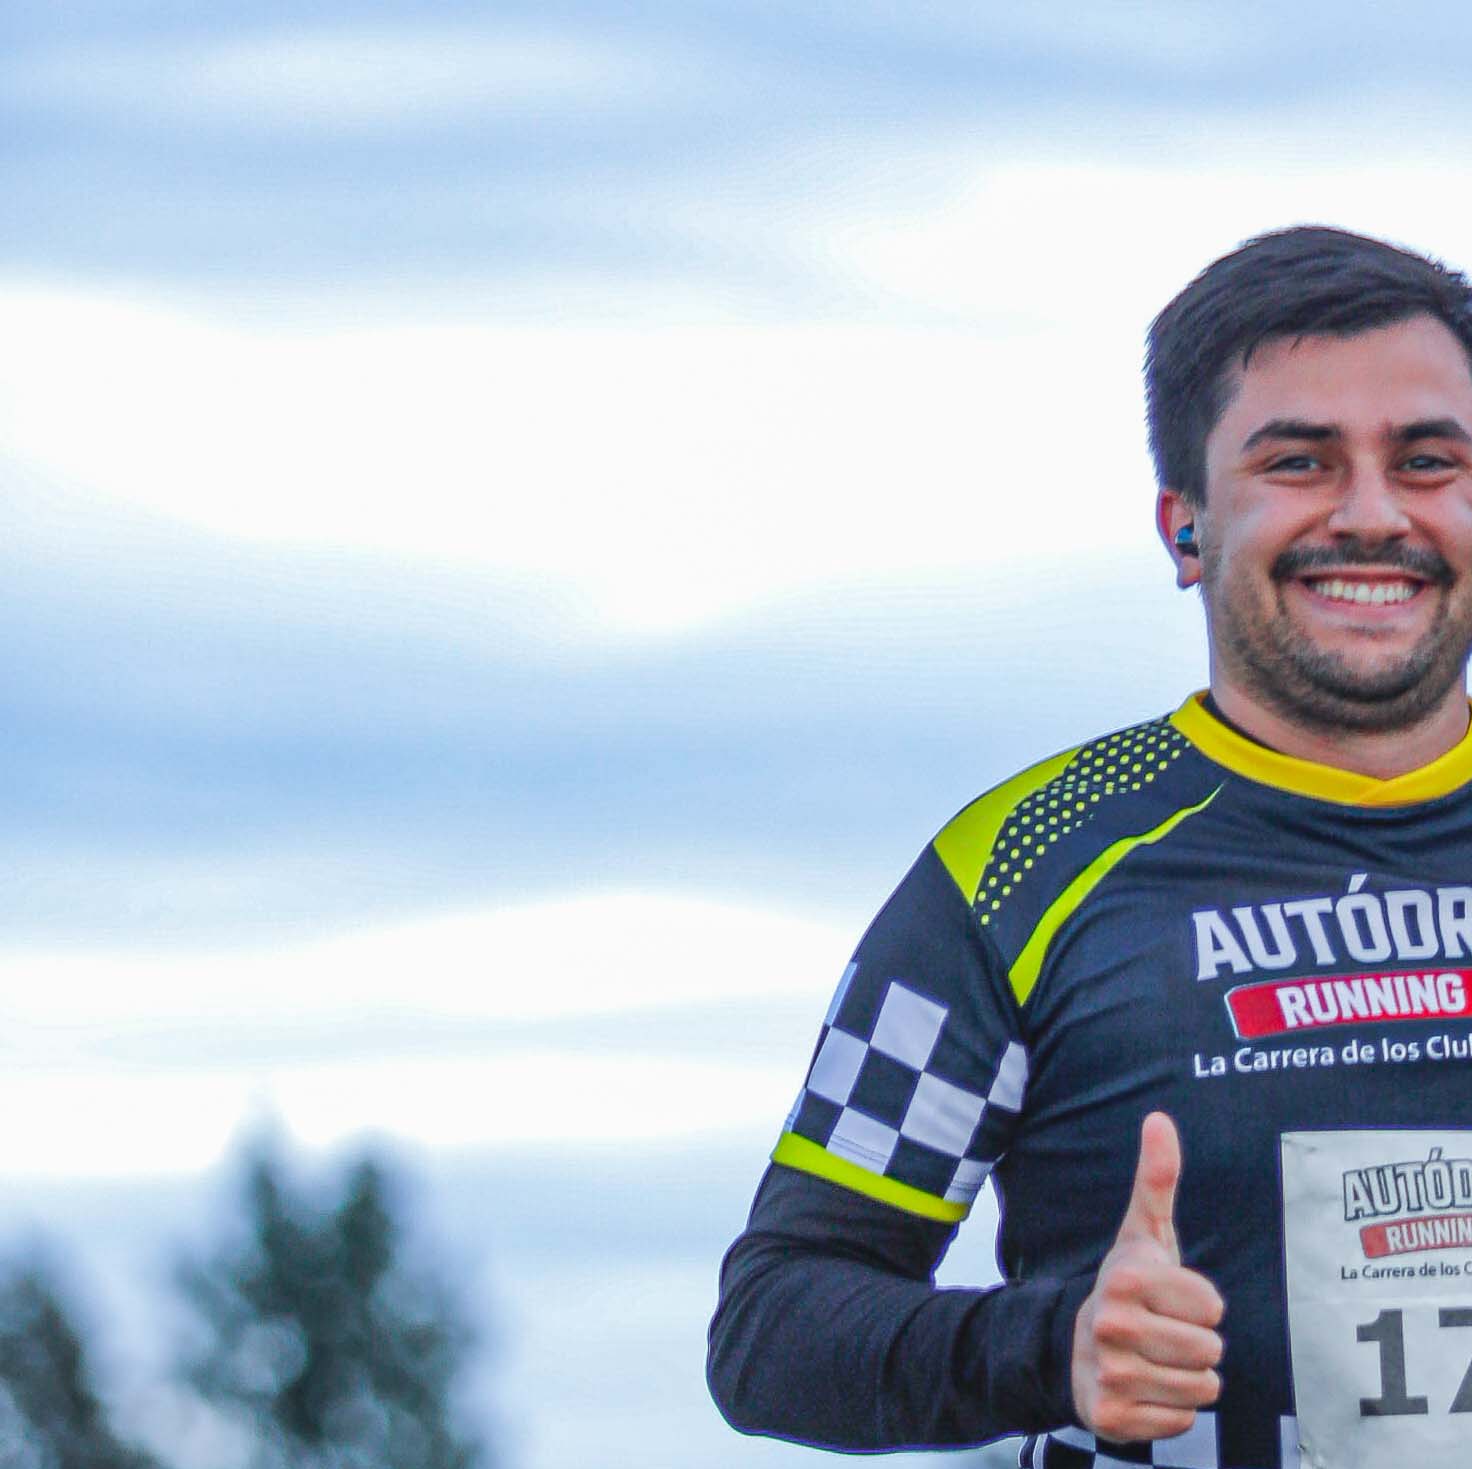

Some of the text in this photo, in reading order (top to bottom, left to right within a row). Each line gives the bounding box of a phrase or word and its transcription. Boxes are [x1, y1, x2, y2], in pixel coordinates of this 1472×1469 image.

[1276, 973, 1467, 1029] RUNNING
[1194, 1053, 1226, 1078] La
[1234, 1046, 1335, 1073] Carrera
[1341, 1039, 1375, 1064] de
[1381, 1037, 1420, 1062] los
[1341, 1265, 1358, 1281] La
[1362, 1264, 1416, 1279] Carrera
[1419, 1261, 1437, 1277] de
[1440, 1261, 1461, 1276] los
